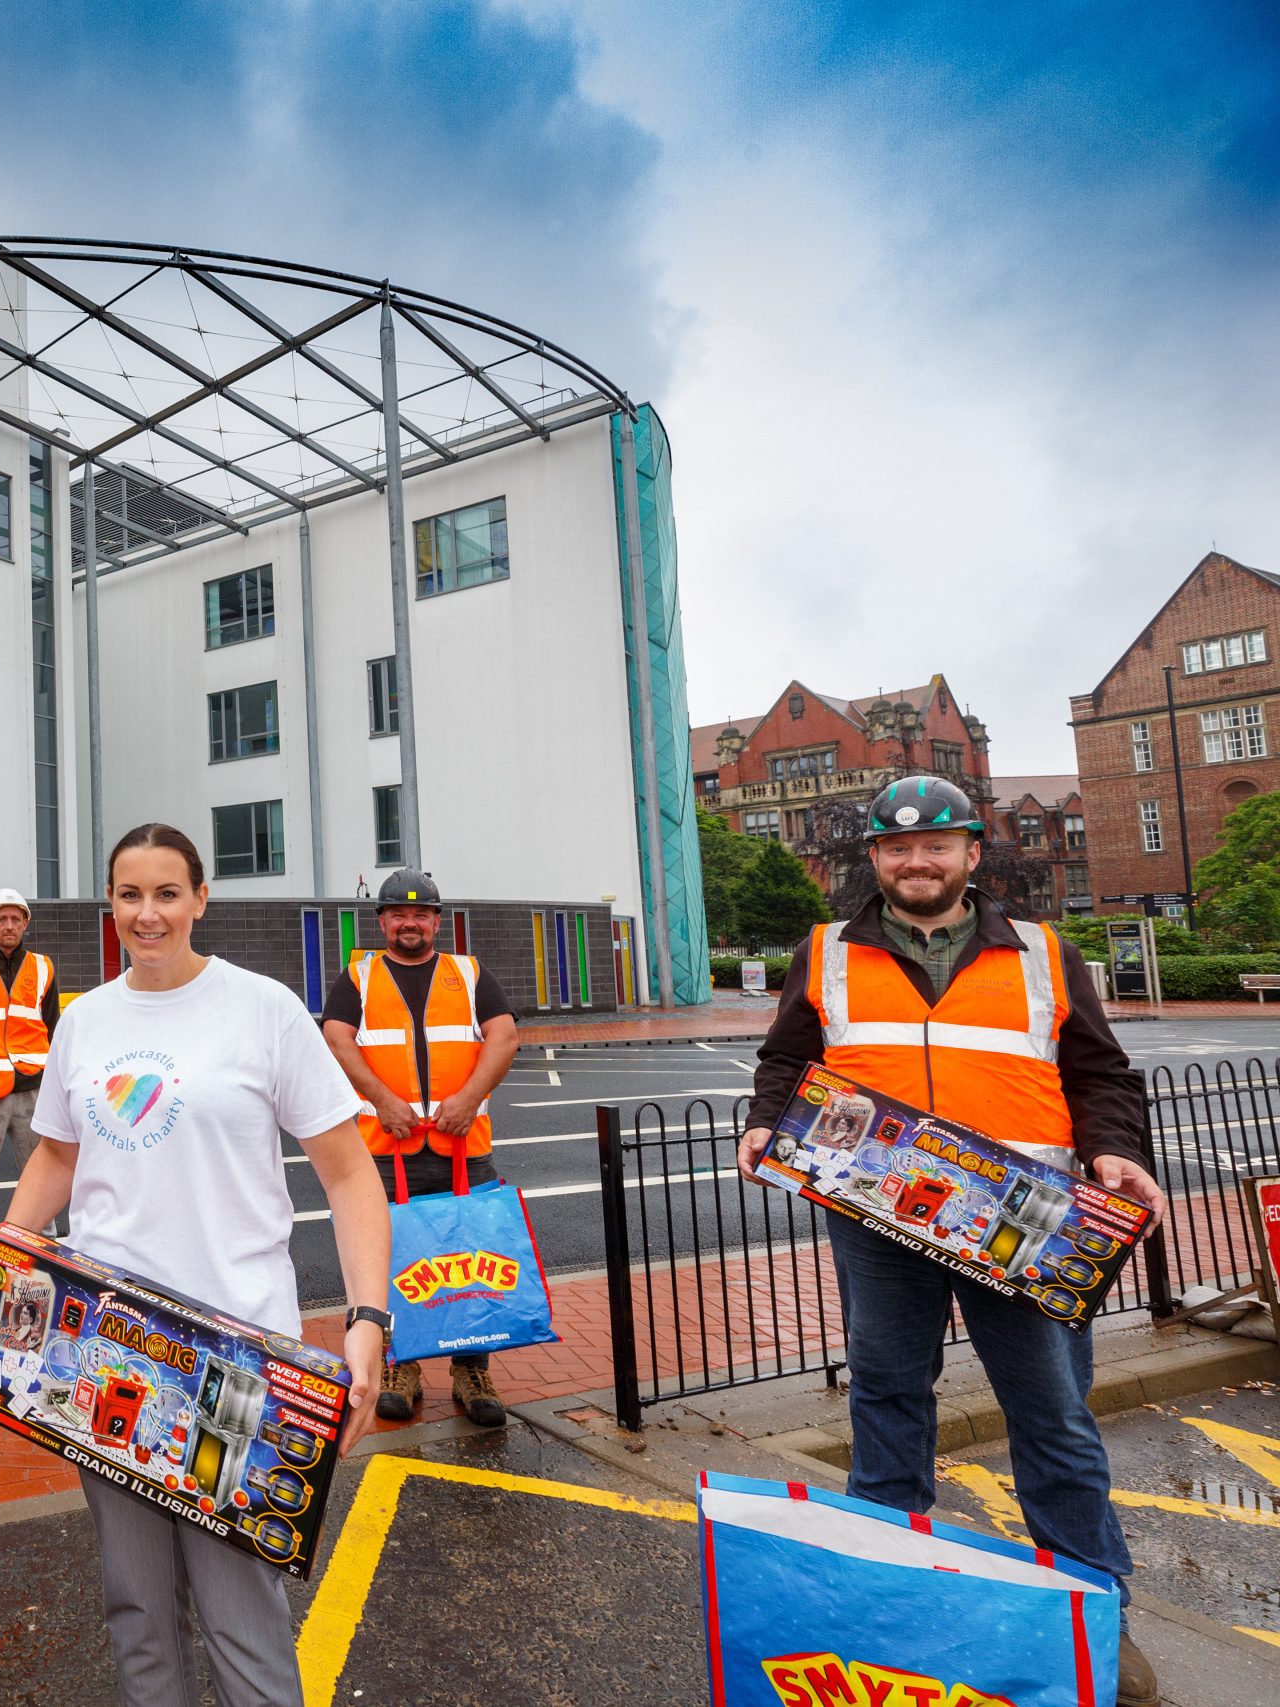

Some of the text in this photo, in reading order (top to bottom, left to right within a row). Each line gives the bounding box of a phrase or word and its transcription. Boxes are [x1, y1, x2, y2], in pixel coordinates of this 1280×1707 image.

[104, 1049, 175, 1072] Newcastle
[813, 1074, 844, 1090] MAGIC
[815, 1071, 852, 1089] AMAZING
[86, 1097, 184, 1151] Hospitals Charity
[912, 1118, 963, 1146] FANTASMA
[912, 1132, 1009, 1185] MAGIC
[1075, 1184, 1142, 1216] OVER 200
[1077, 1192, 1139, 1221] MAGIC TRICKS!
[831, 1204, 1017, 1297] DELUXE GRAND ILLUSIONS
[398, 1256, 517, 1300] SMYTHS
[94, 1292, 147, 1325] FANTASMA
[105, 1278, 158, 1303] GRAND
[161, 1301, 240, 1337] ILLUSIONS
[423, 1290, 504, 1310] TOYS SUPERSTORES
[97, 1312, 197, 1375] MAGIC
[438, 1332, 510, 1348] SmythsToys.com
[266, 1361, 339, 1398] OVER 200
[270, 1373, 336, 1405] MAGIC TRICKS!
[285, 1415, 300, 1424] 360
[295, 1395, 316, 1408] FOLLOW
[317, 1405, 334, 1415] VIDEO
[114, 1420, 123, 1433] ?
[30, 1430, 229, 1537] DELUXE GRAND ILLUSIONS
